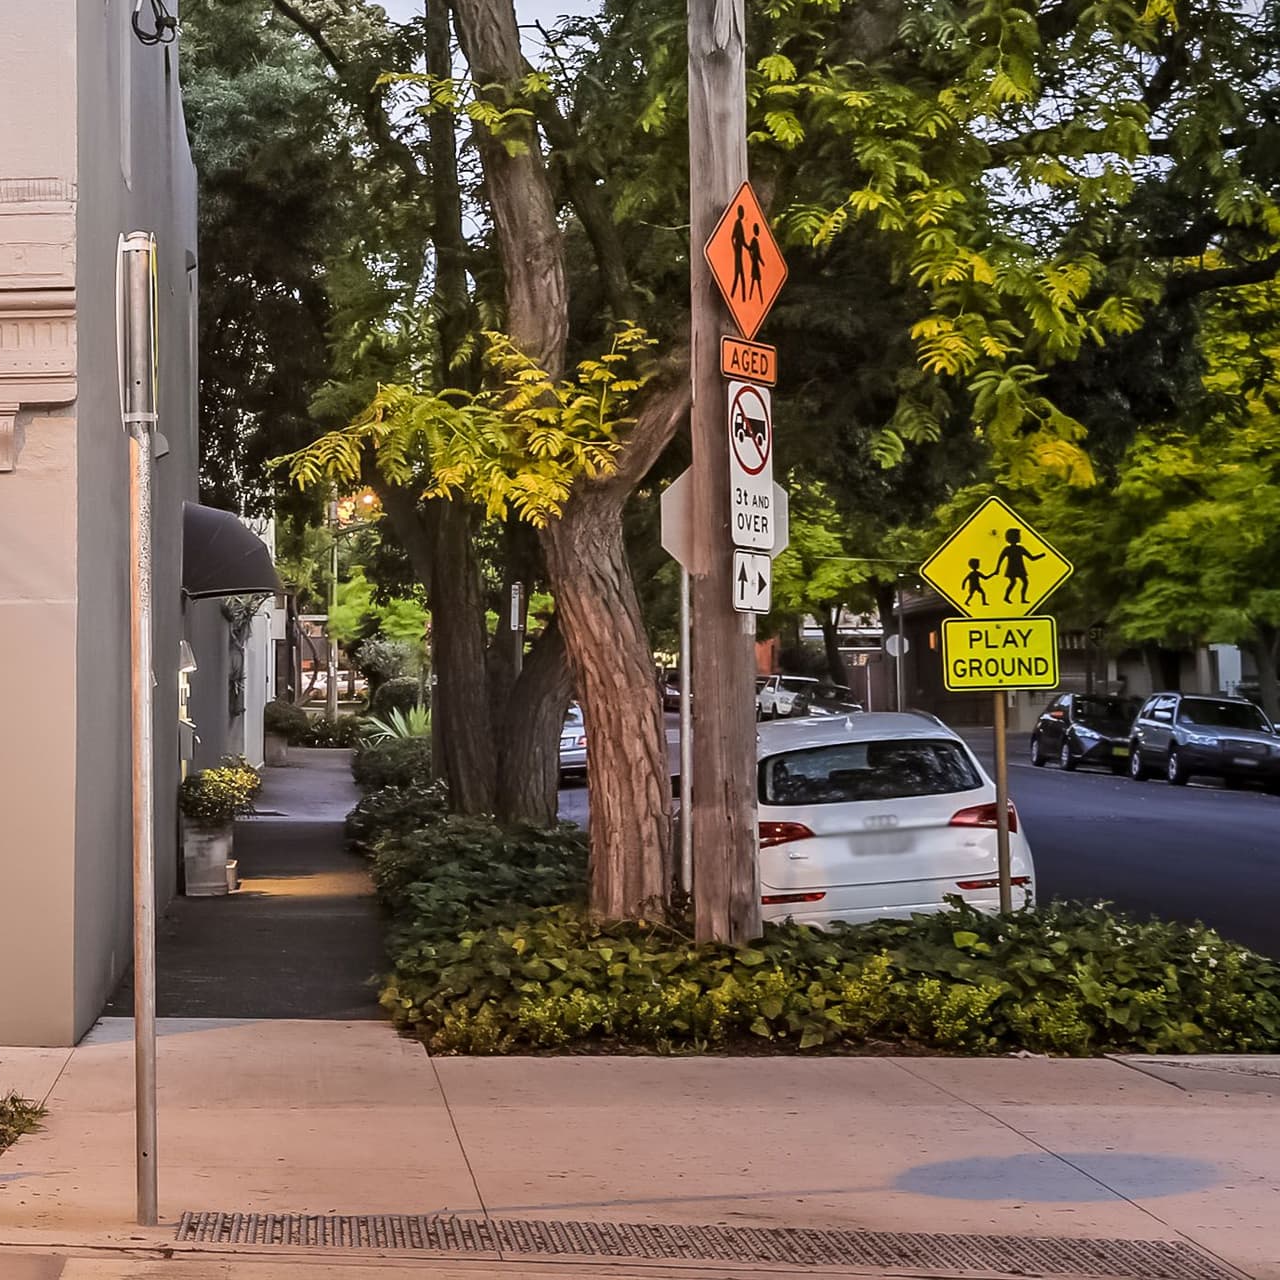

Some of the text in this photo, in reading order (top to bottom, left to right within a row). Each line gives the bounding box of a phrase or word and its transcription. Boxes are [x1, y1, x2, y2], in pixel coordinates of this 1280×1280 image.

[731, 347, 769, 376] AGED
[735, 487, 770, 509] 3t AND
[737, 513, 768, 534] OVER
[968, 629, 1033, 650] PLAY
[953, 657, 1049, 678] GROUND
